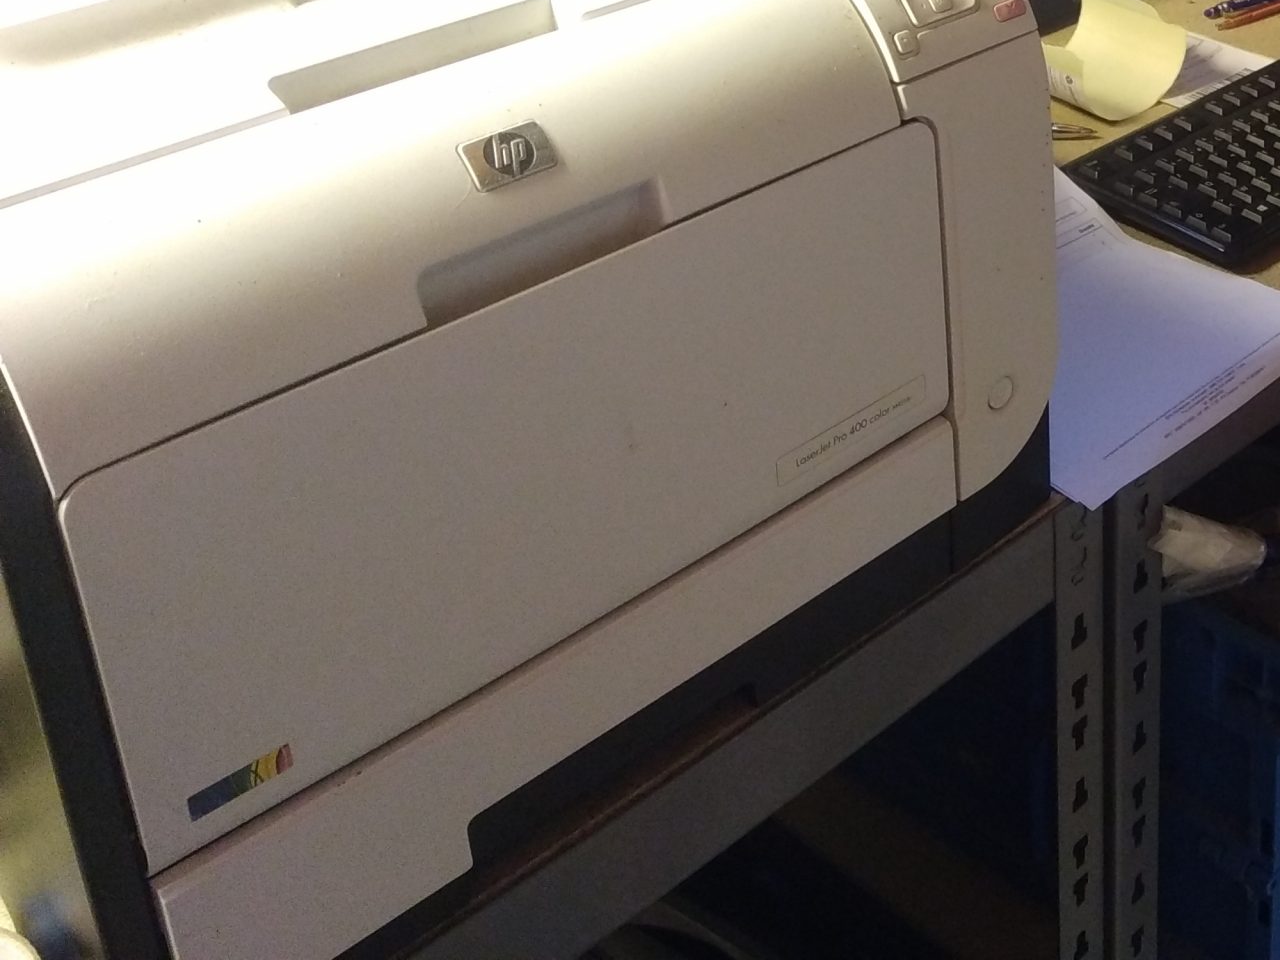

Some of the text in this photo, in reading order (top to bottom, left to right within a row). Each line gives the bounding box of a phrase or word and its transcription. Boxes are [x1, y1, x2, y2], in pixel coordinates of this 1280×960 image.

[492, 133, 527, 177] hp
[795, 407, 890, 468] LaserJet Pro 400 color
